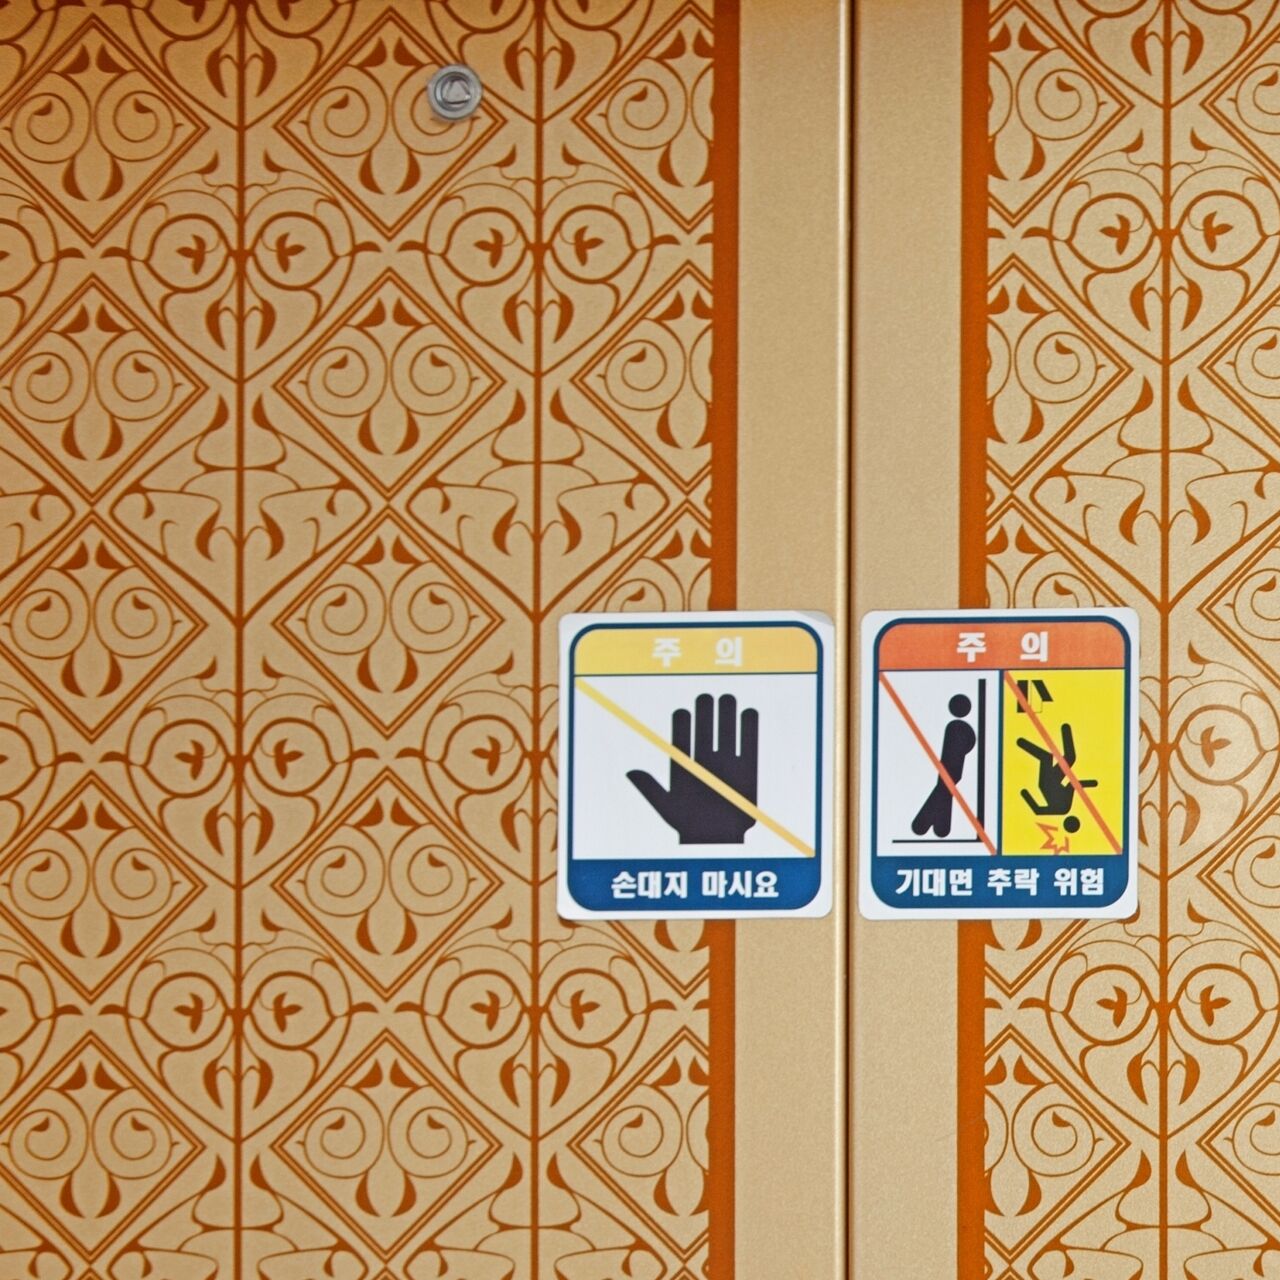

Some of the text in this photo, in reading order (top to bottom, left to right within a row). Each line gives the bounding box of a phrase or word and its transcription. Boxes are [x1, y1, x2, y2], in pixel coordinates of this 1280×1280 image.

[611, 870, 779, 899] 손대지 마시요
[895, 867, 1105, 897] 기대면 추락 위험
